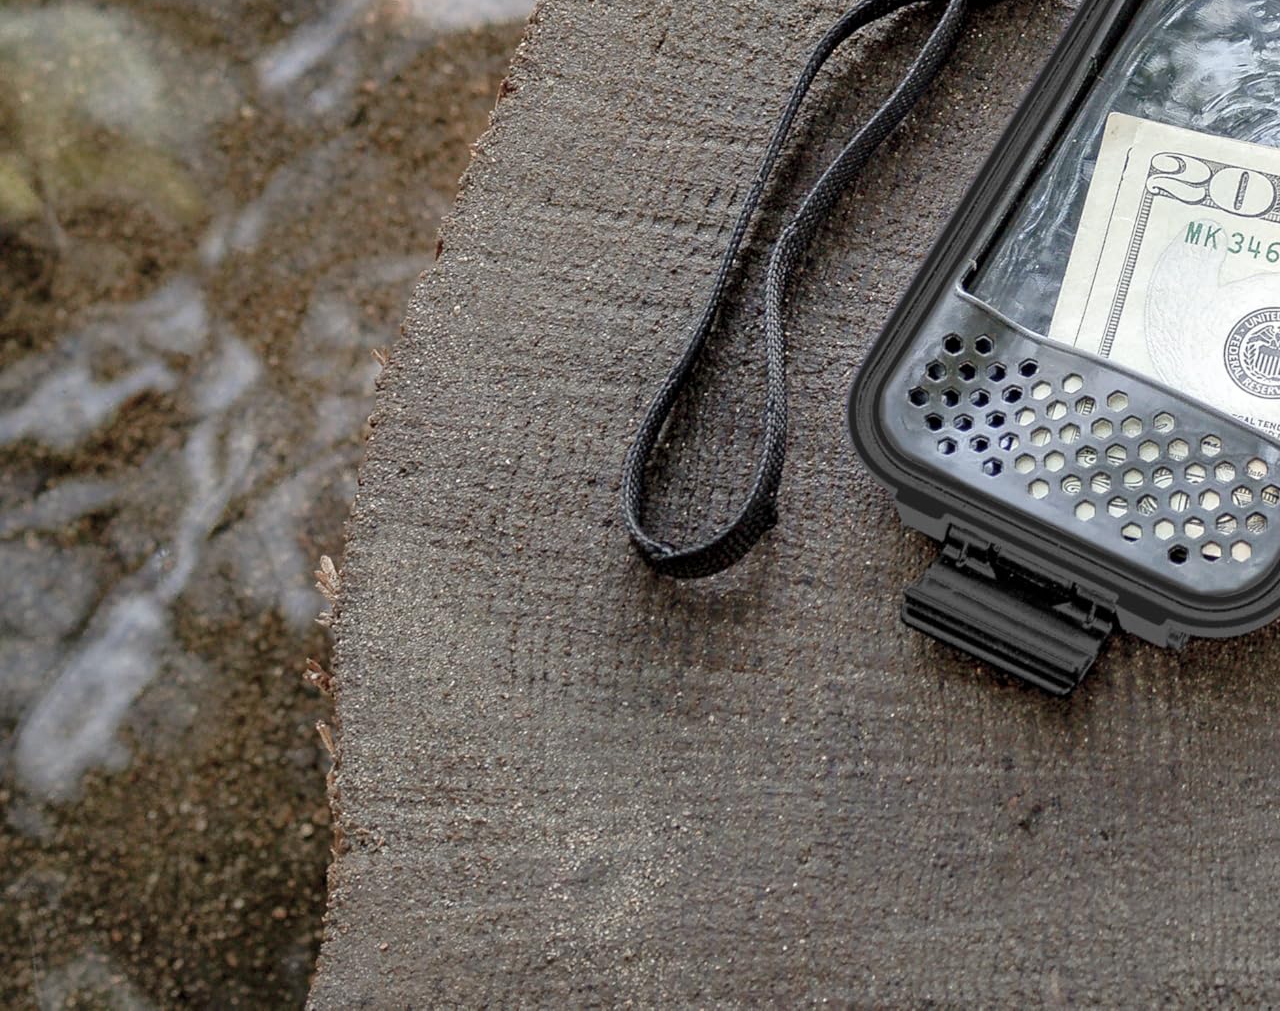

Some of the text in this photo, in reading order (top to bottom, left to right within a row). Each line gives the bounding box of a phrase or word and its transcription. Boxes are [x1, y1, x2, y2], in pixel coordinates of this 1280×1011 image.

[1146, 152, 1277, 218] 20
[1184, 220, 1222, 250] MK
[1228, 333, 1245, 378] FEDERAL
